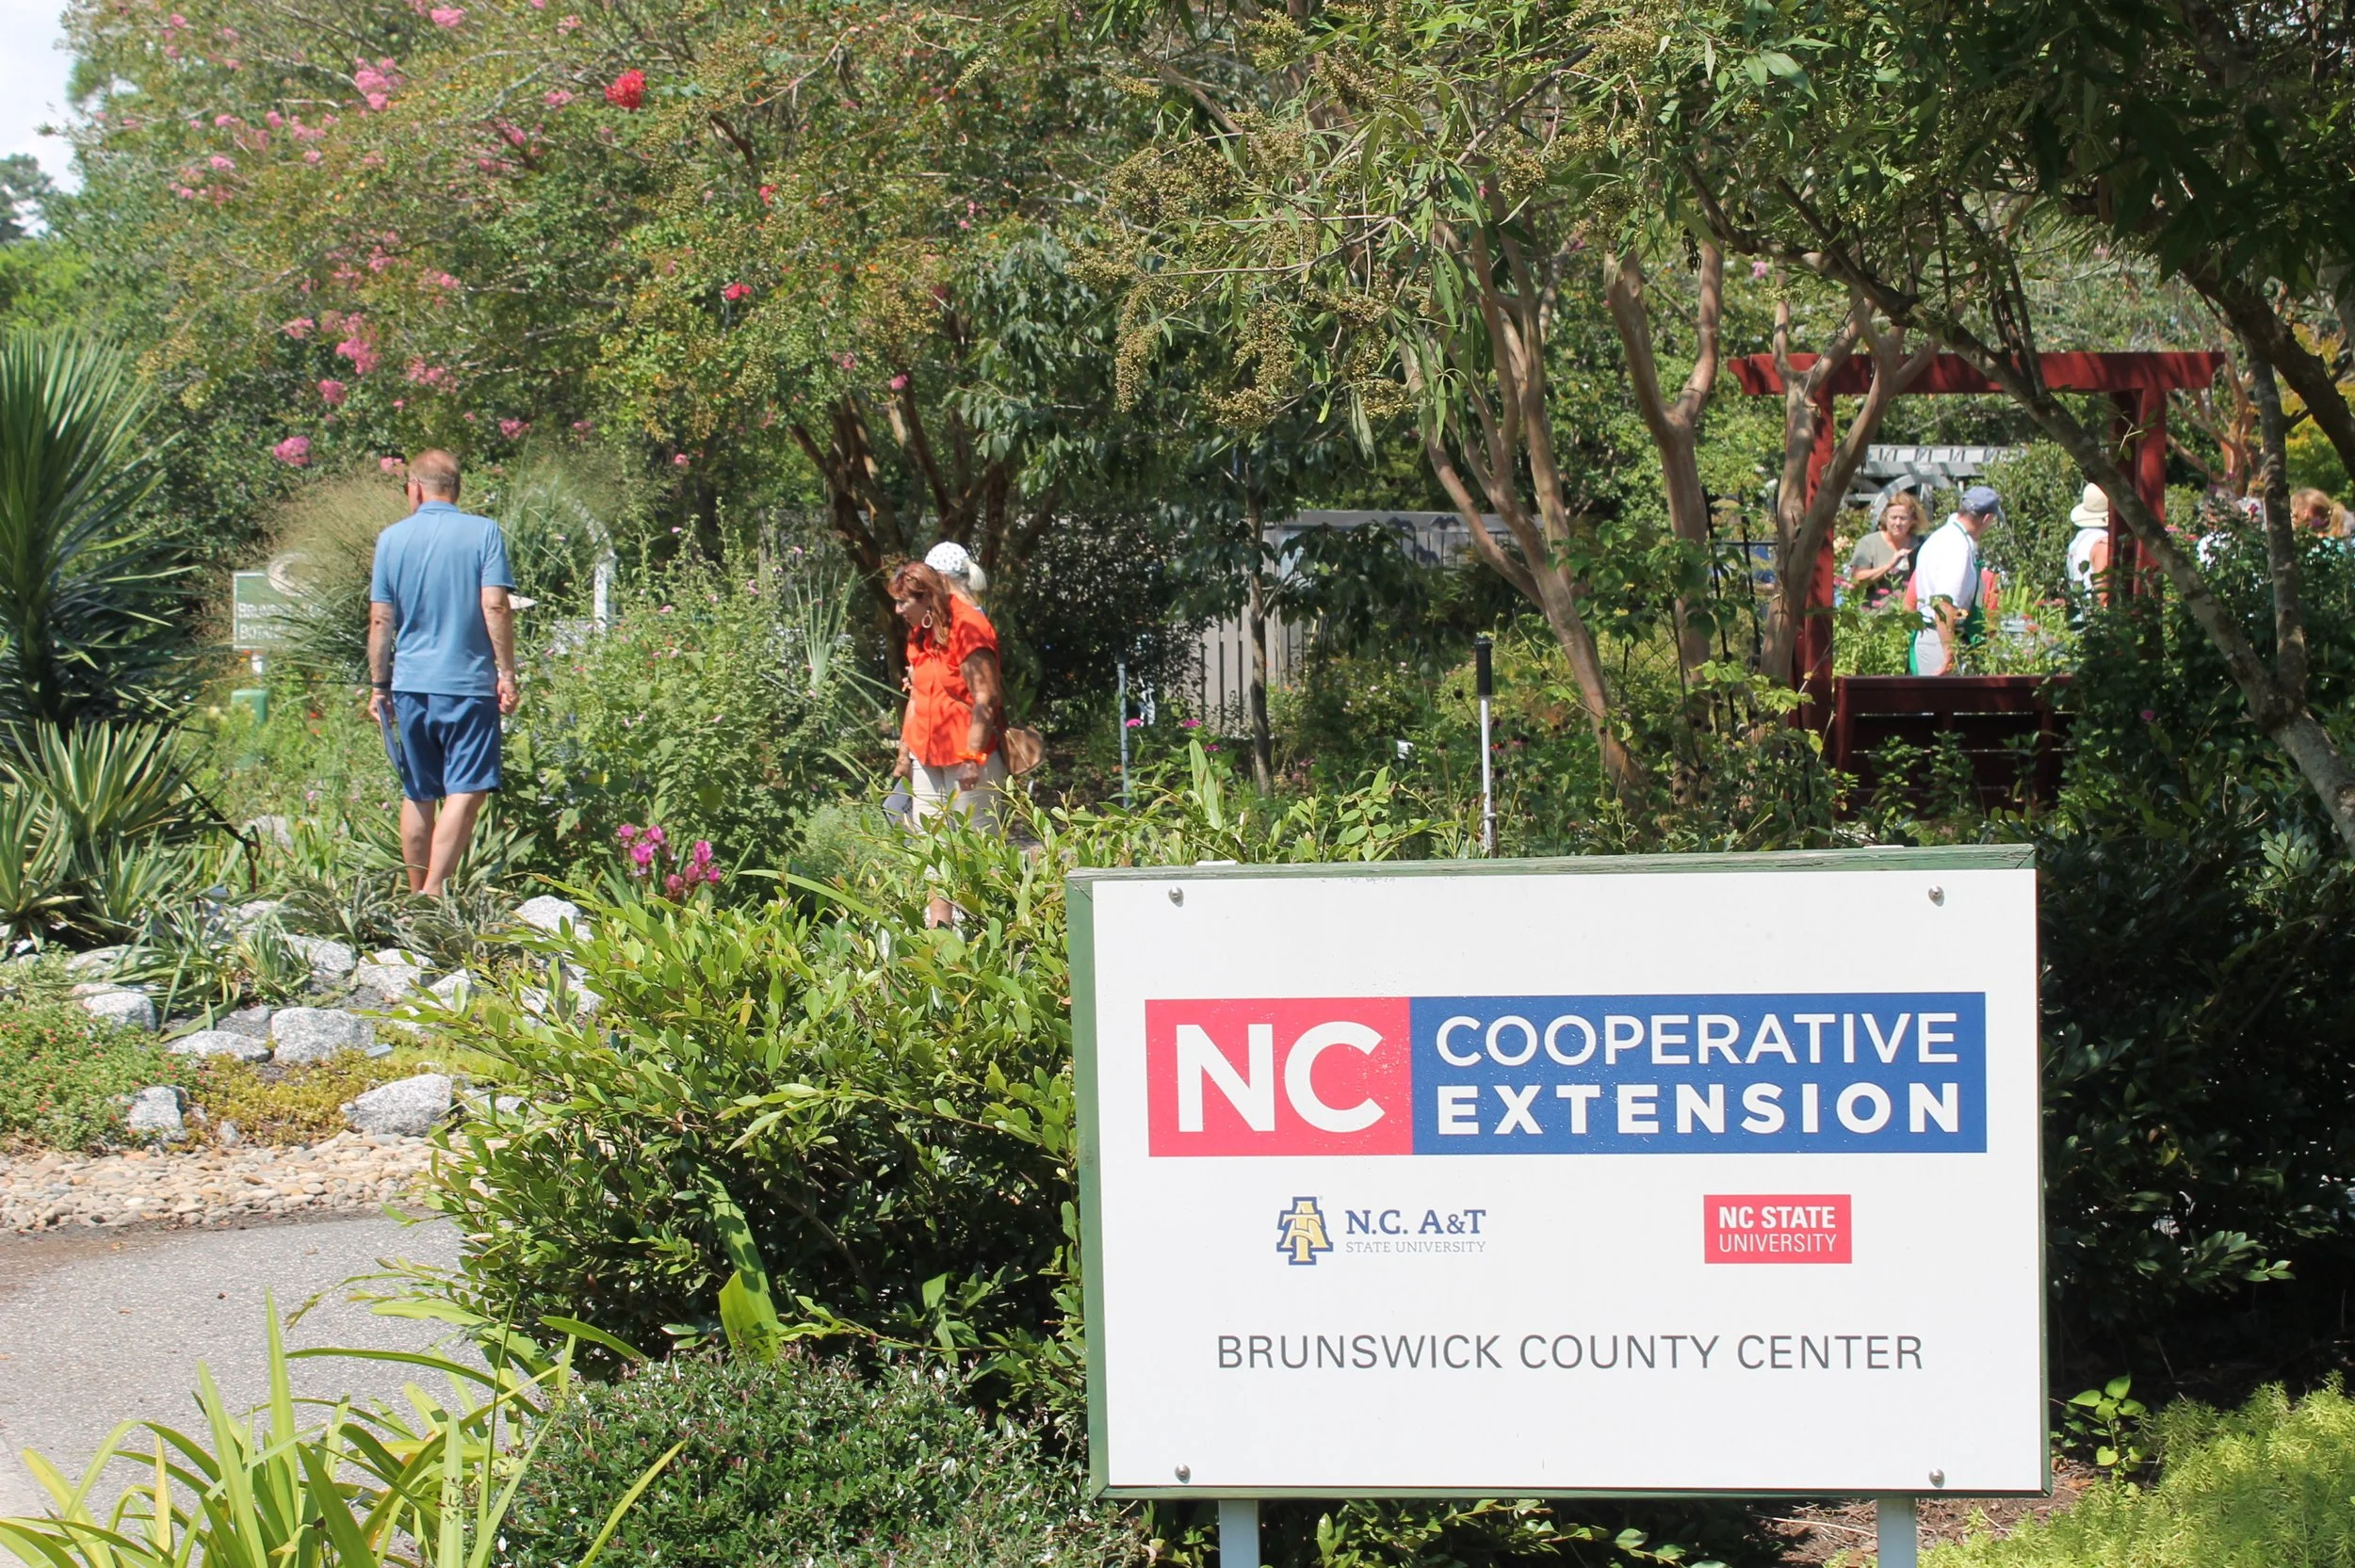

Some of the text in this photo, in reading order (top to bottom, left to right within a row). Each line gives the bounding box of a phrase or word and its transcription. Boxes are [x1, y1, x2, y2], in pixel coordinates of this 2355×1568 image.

[1437, 1012, 1957, 1067] COOPERATIVE
[1177, 1023, 1387, 1132] NC
[1437, 1082, 1958, 1135] EXTENSION
[1345, 1209, 1486, 1235] N.C. A&T
[1719, 1206, 1836, 1229] NC STATE
[1345, 1241, 1486, 1253] STATE UNIVERSITY
[1719, 1233, 1837, 1253] UNIVERSITY
[1218, 1334, 1923, 1370] BRUNSWICK COUNTY CENTER
